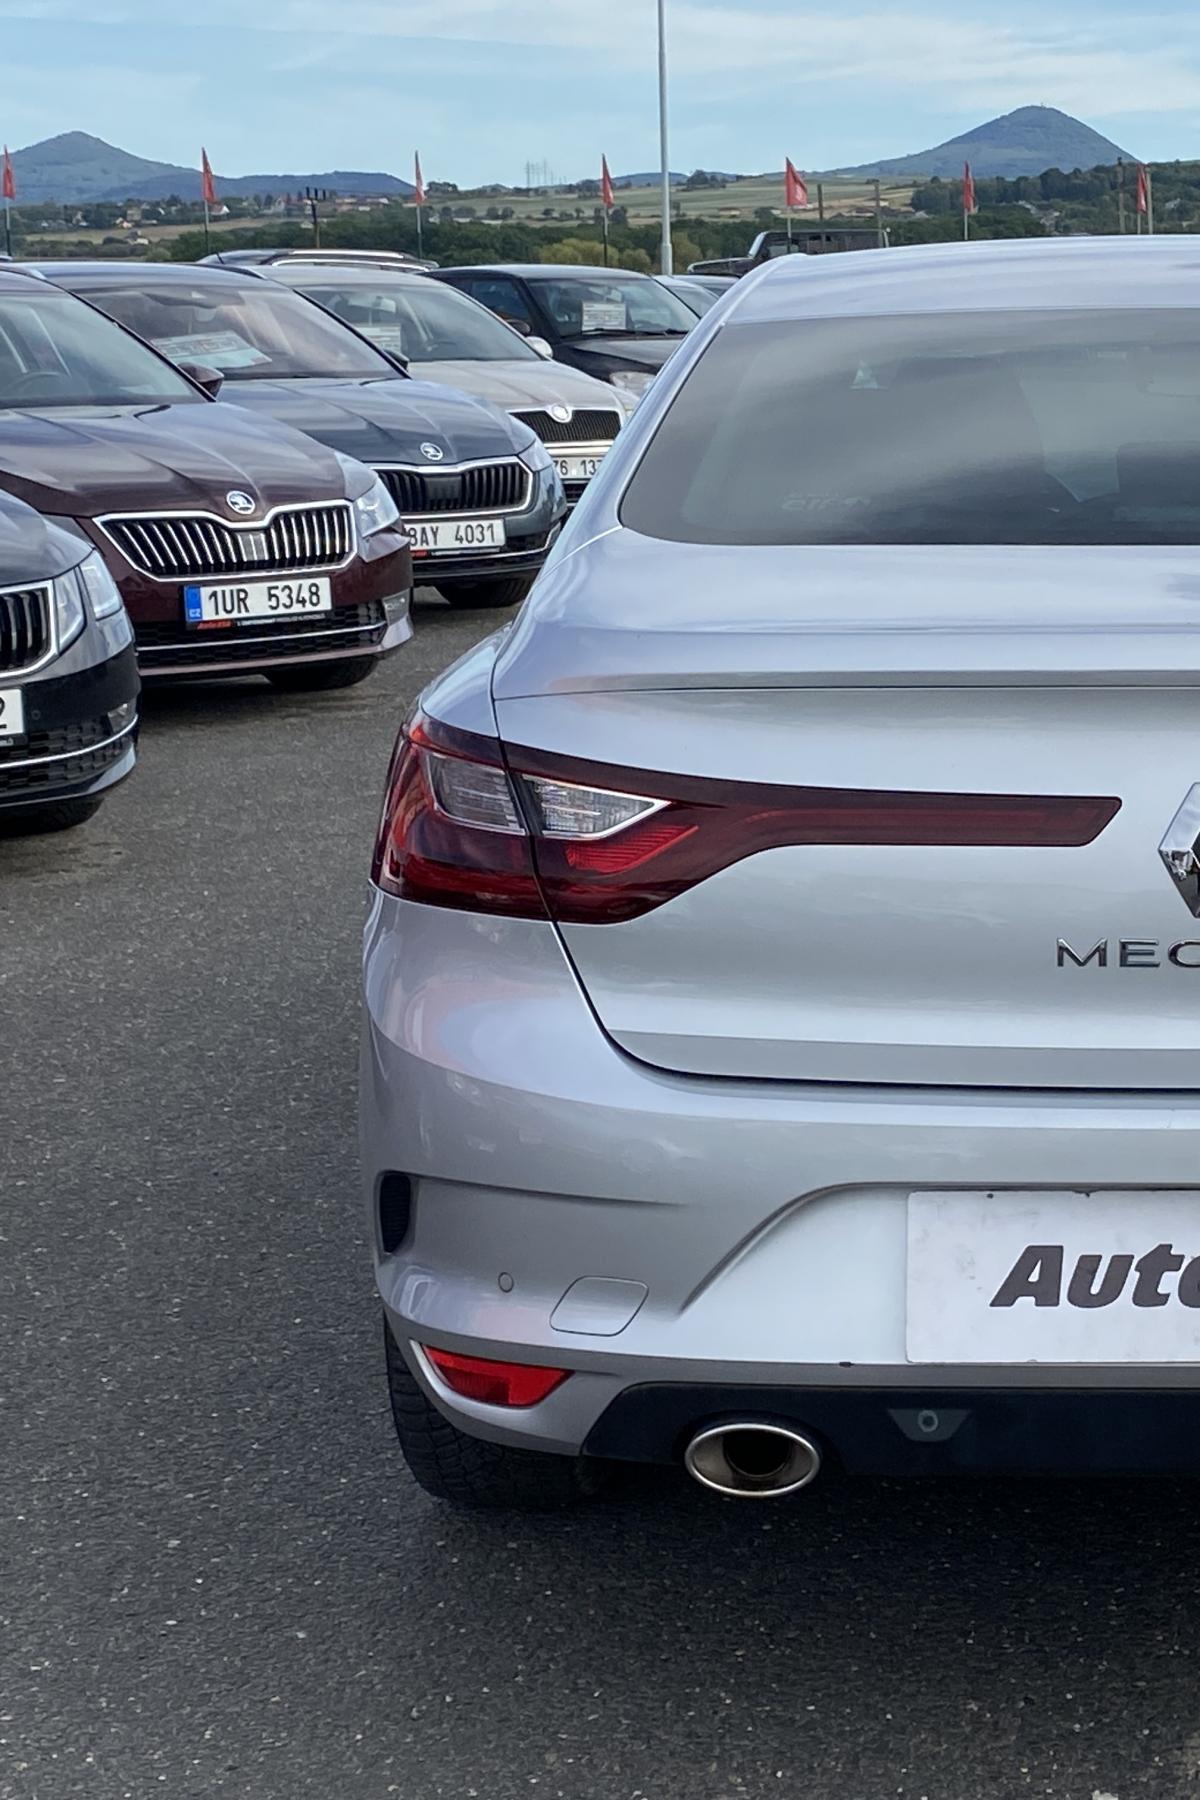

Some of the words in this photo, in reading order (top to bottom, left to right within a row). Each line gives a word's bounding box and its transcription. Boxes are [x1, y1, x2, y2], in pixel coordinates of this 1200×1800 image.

[408, 525, 439, 546] 8AY
[454, 523, 495, 544] 4031
[208, 588, 250, 616] 1UR
[267, 582, 320, 610] 5348
